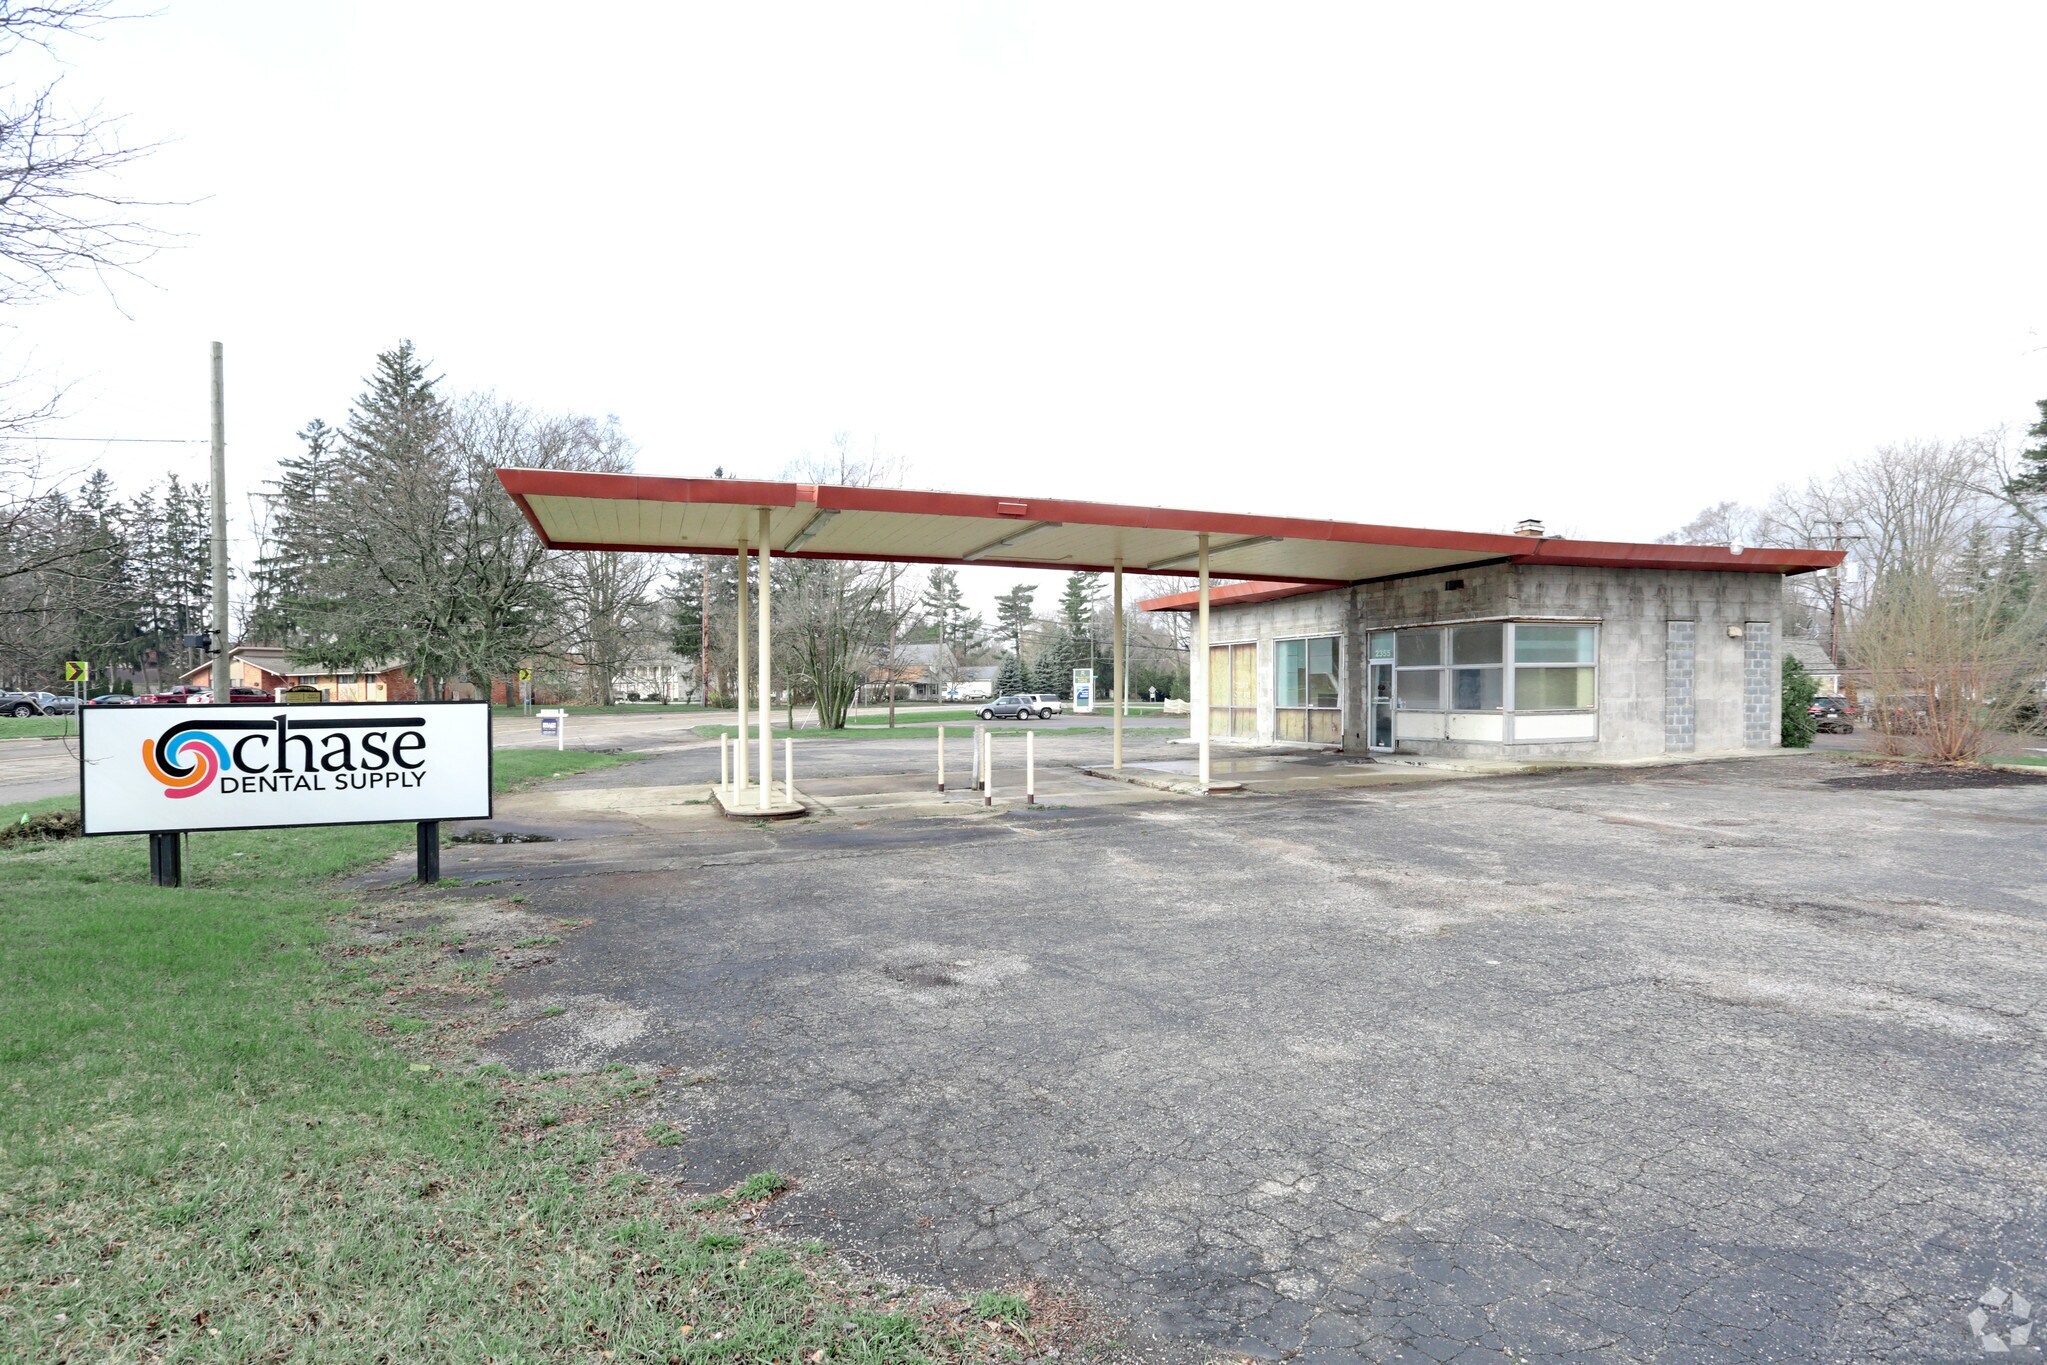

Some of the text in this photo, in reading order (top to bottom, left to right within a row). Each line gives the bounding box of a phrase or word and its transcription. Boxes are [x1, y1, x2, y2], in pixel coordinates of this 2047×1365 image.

[232, 714, 426, 774] chase
[220, 771, 426, 794] DENTAL SUPPLY
